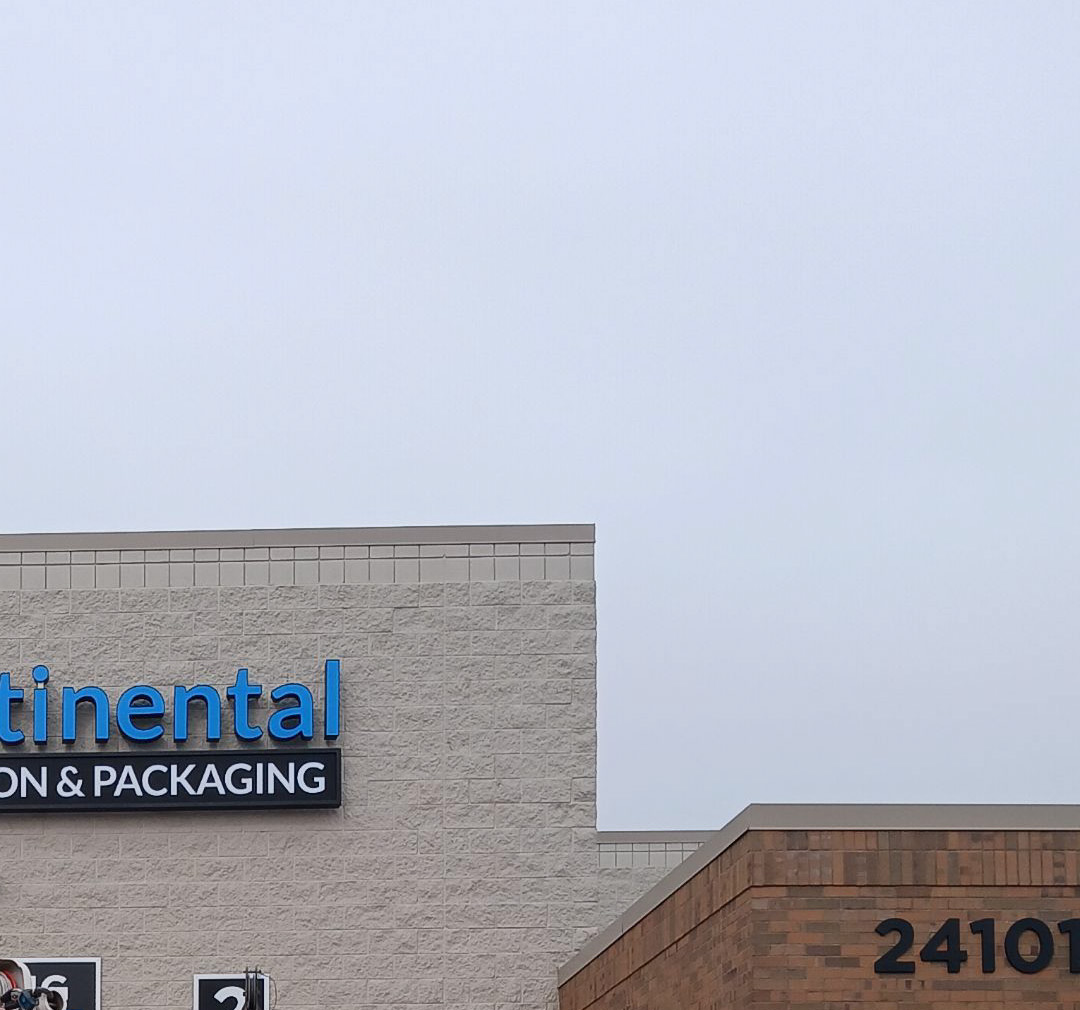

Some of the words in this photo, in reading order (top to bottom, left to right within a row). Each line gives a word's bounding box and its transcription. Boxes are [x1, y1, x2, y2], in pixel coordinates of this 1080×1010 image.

[59, 764, 86, 798] &
[94, 761, 326, 798] PACKAGING
[874, 917, 1080, 974] 24101
